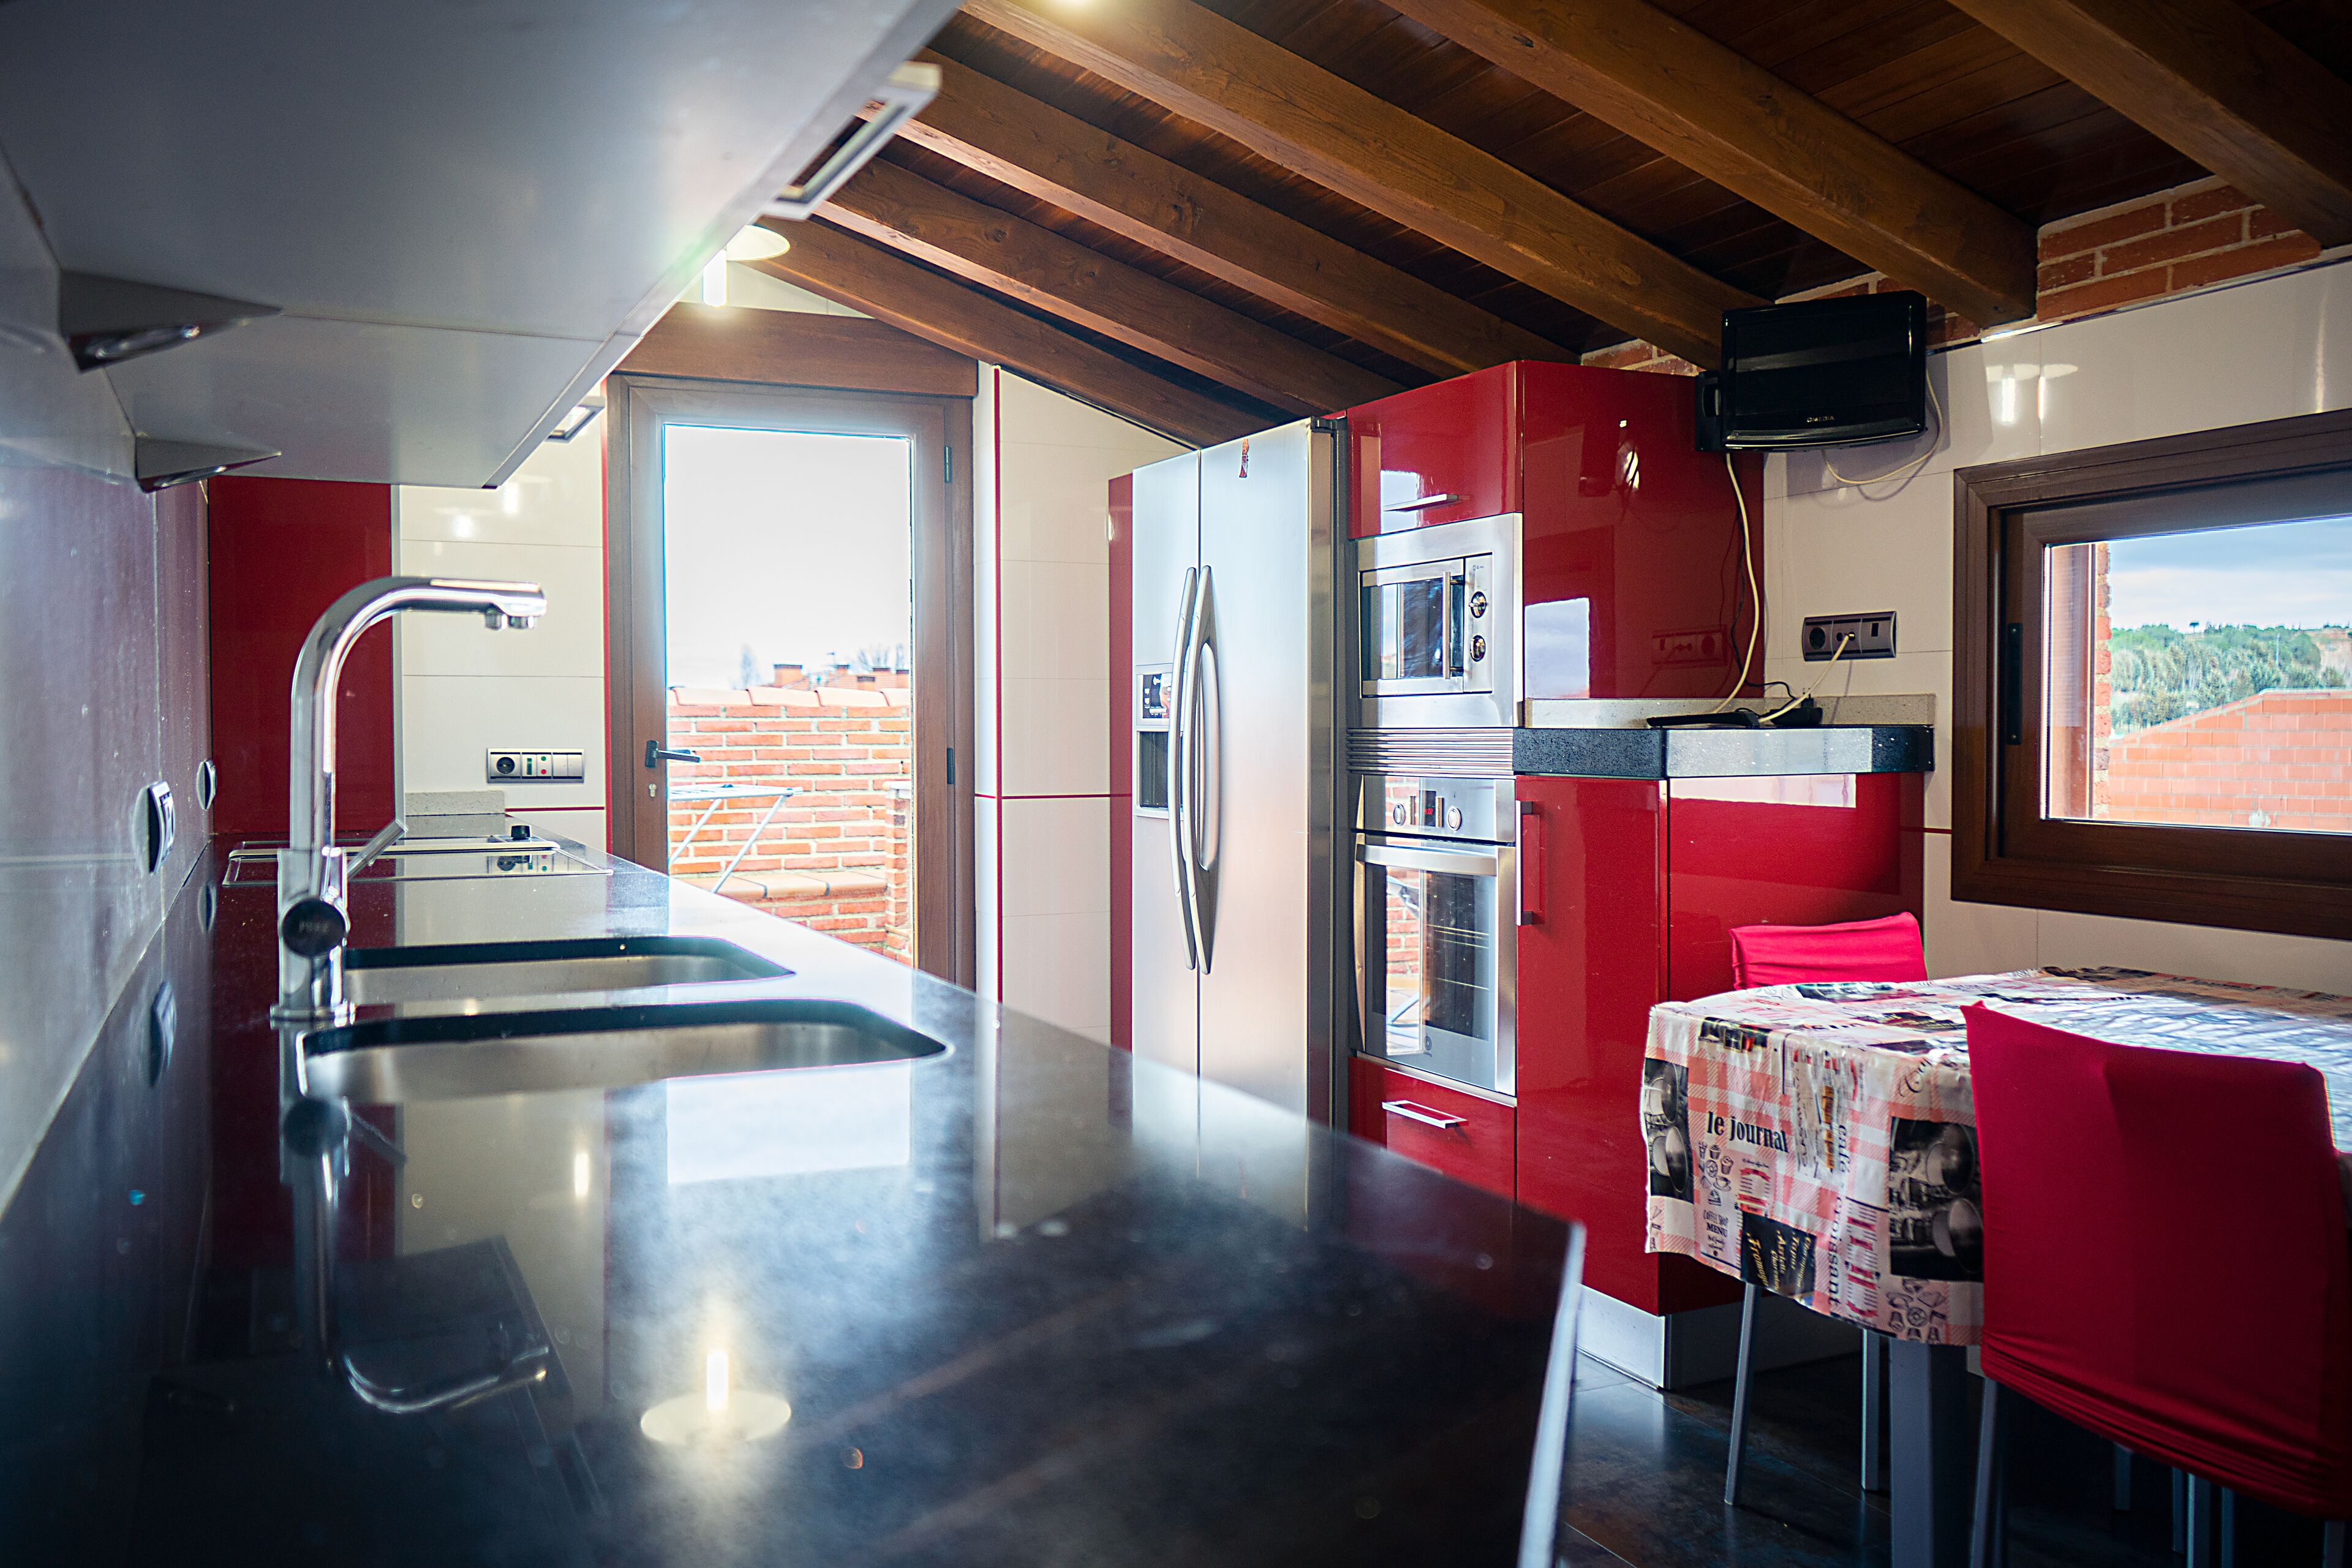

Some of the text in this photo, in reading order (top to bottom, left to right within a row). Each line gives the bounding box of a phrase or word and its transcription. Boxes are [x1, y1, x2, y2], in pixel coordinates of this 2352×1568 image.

[1707, 1110, 1789, 1153] le journal
[1706, 1222, 1728, 1238] MENU
[1828, 1196, 1842, 1305] croissant
